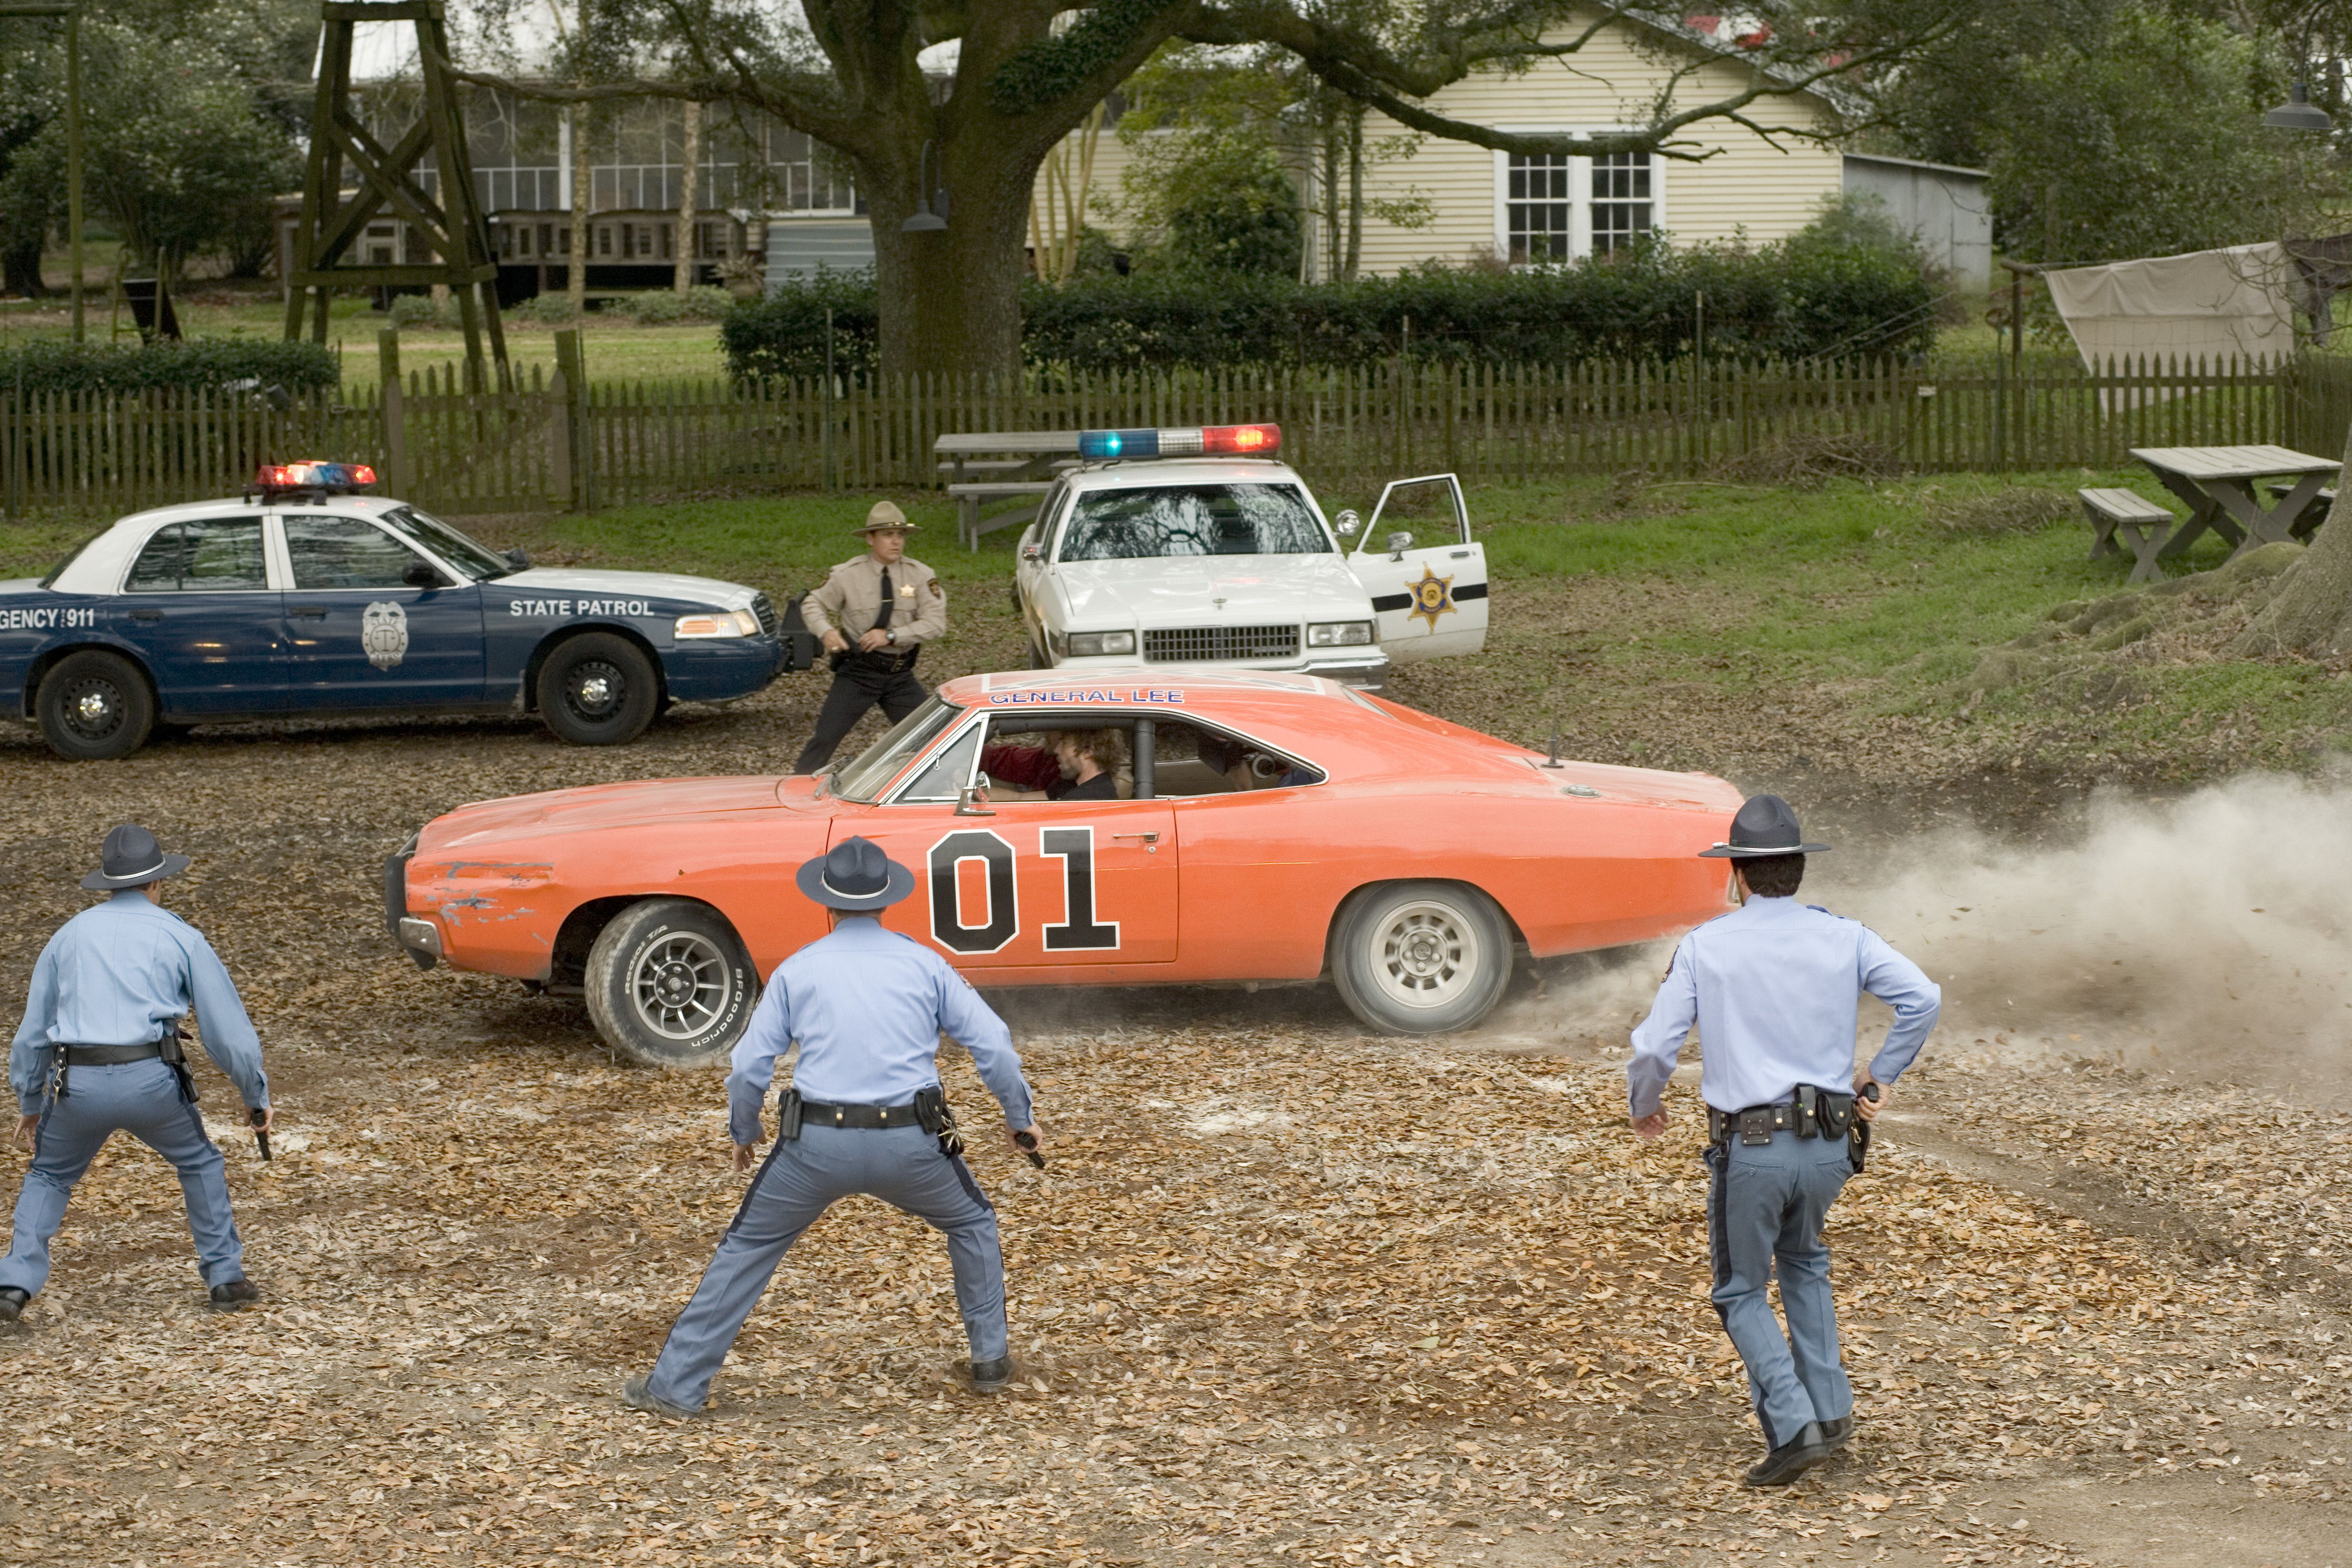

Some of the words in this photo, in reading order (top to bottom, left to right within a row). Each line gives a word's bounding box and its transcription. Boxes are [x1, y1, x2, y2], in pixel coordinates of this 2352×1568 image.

[0, 608, 58, 629] GENCY
[66, 608, 94, 628] 911
[510, 600, 571, 616] STATE
[577, 600, 654, 616] PATROL
[989, 690, 1124, 704] GENERAL
[1131, 690, 1185, 703] LEE
[927, 825, 1120, 956] 01
[625, 941, 646, 995] Radial
[646, 924, 668, 940] T/A
[691, 968, 743, 1047] BFGoodrich
